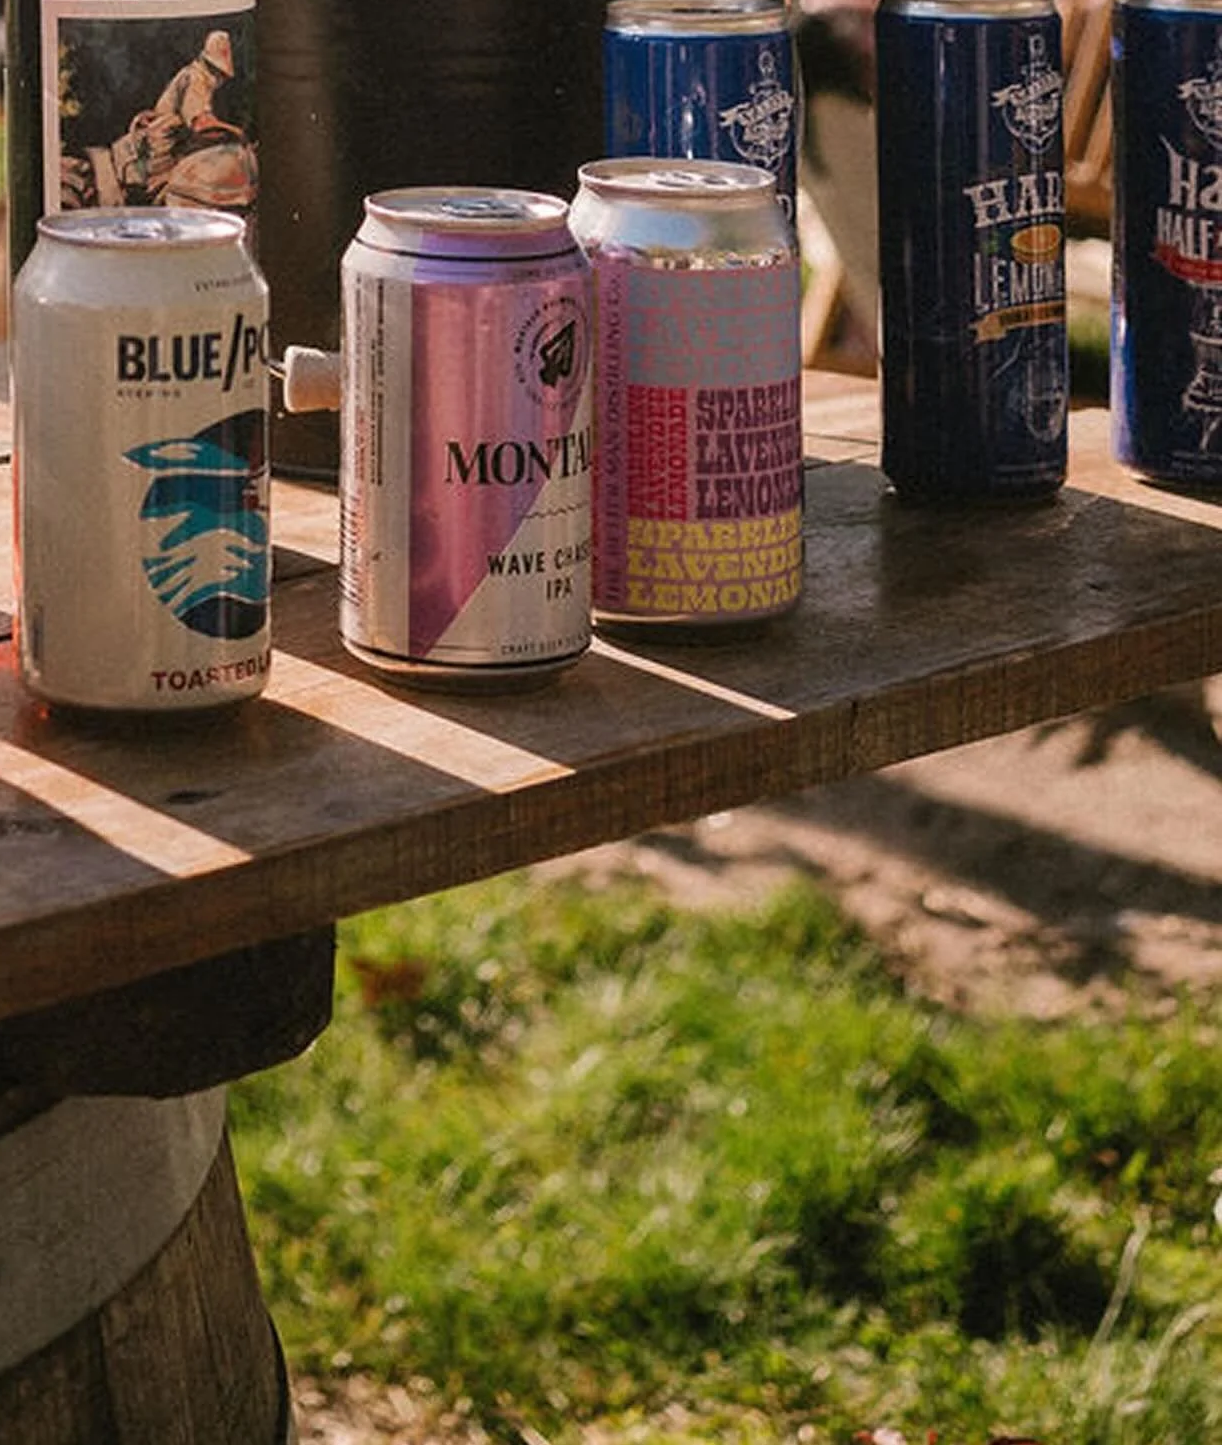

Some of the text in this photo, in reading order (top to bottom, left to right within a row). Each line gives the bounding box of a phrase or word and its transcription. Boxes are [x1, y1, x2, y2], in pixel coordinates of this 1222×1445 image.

[1157, 208, 1215, 260] HALF
[487, 552, 545, 575] WAVE
[546, 578, 574, 601] IPA
[150, 658, 256, 692] TOASTED
